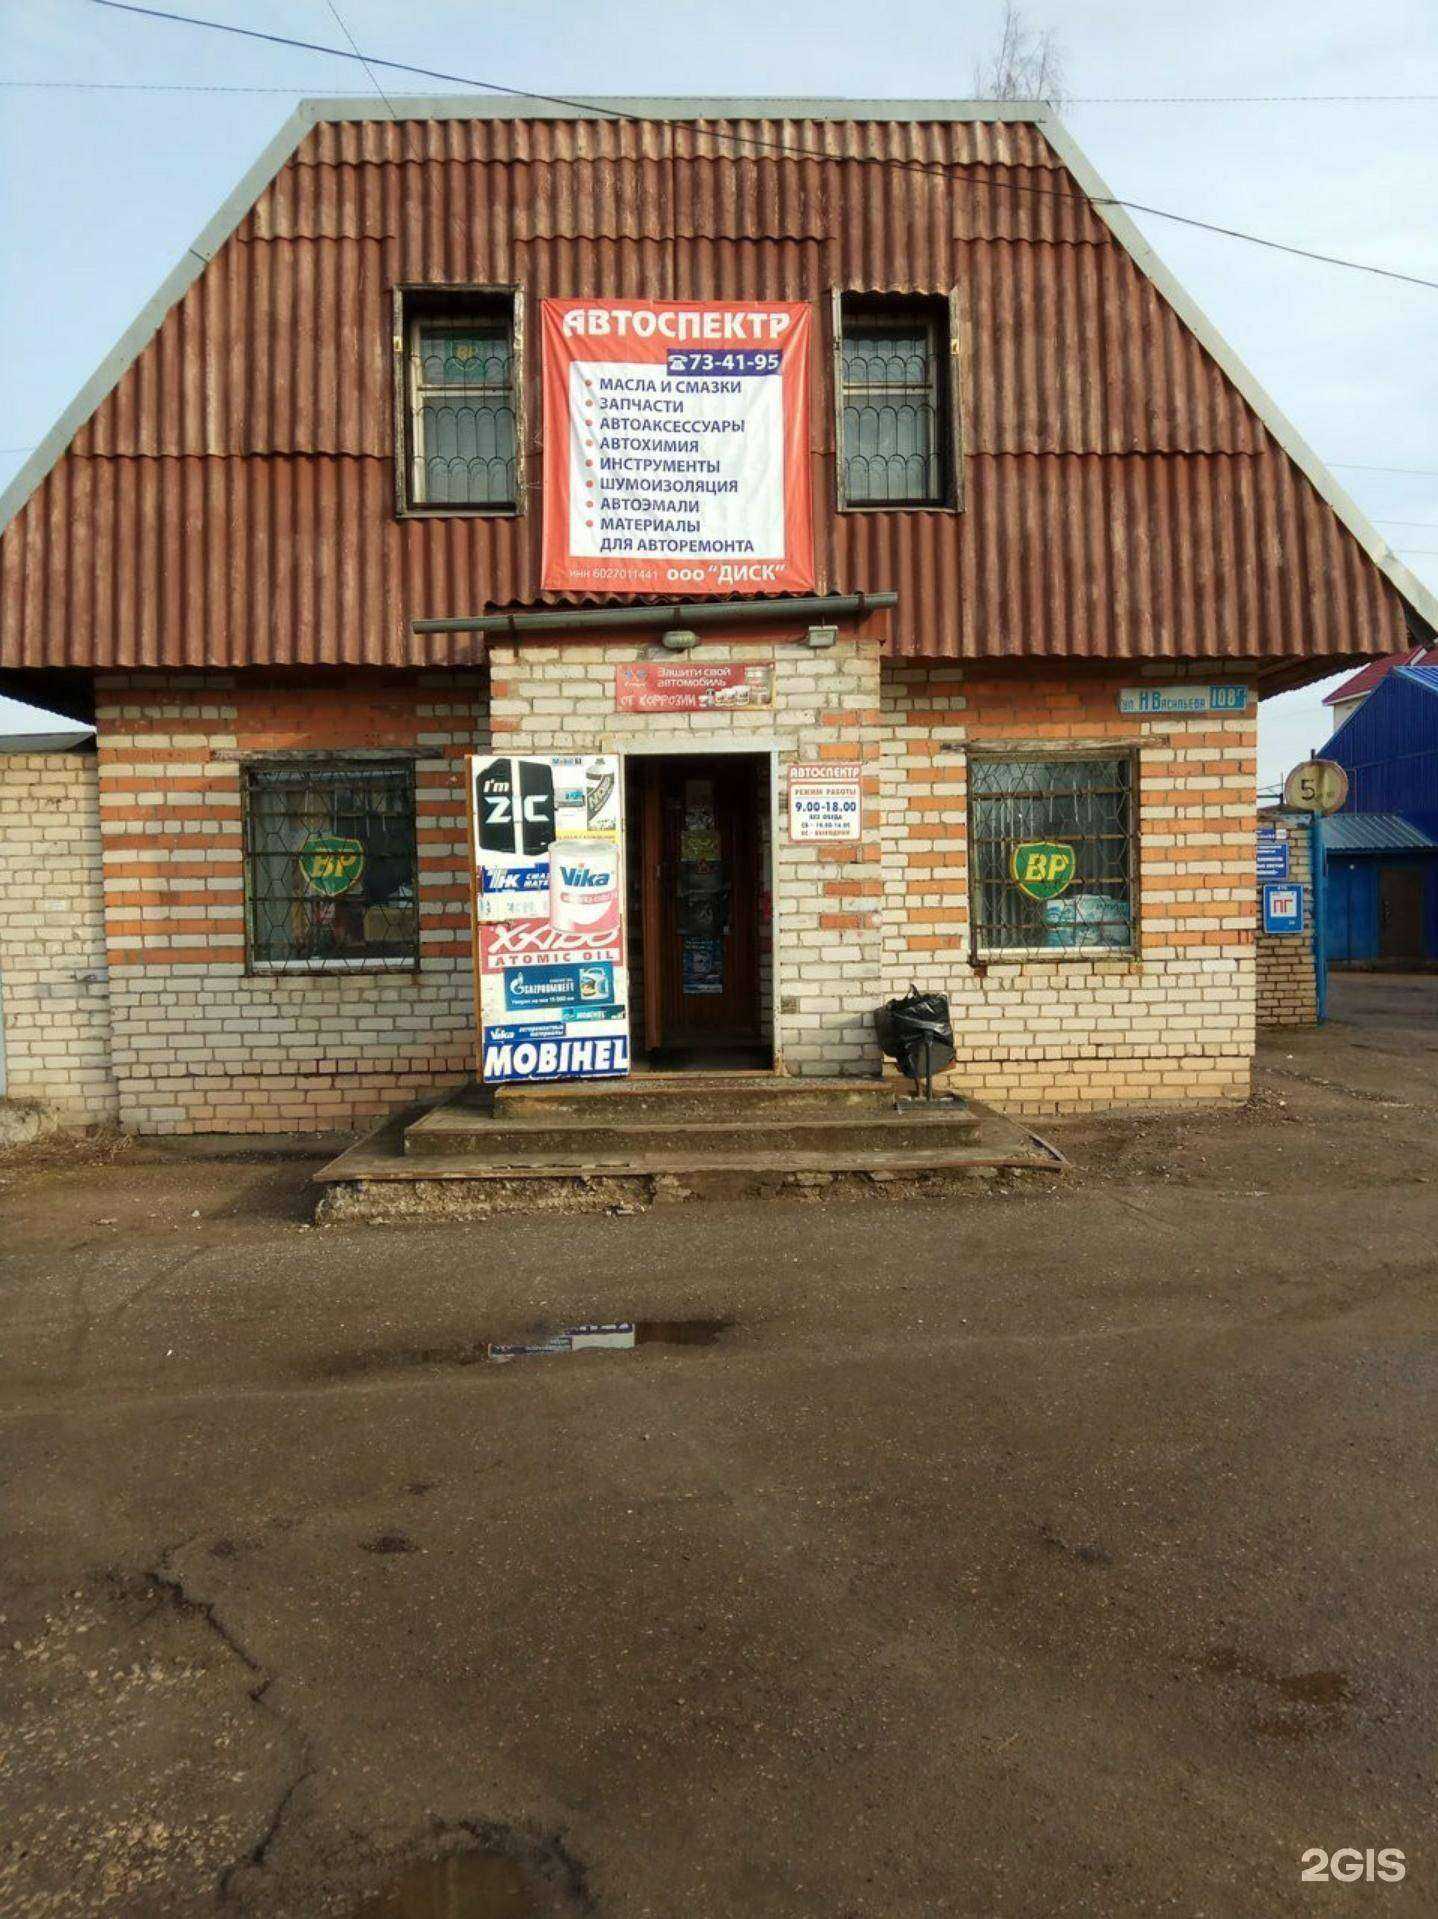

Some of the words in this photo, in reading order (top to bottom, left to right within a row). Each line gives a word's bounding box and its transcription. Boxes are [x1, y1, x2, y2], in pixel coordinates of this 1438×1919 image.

[563, 308, 792, 341] АВТОСПЕКТР
[690, 354, 780, 370] 73-41-95
[599, 378, 657, 392] МАСЛА
[661, 380, 672, 392] И
[676, 379, 742, 394] СМАЗКИ
[599, 399, 684, 413] ЗАПЧАСТИ
[599, 418, 746, 432] АВТОАКСЕССУАРЫ
[599, 437, 699, 452] АВТОХИМИЯ
[599, 457, 721, 473] ИНСТРУМЕНТЫ
[599, 478, 739, 494] ШУМОИЗОЛЯЦИЯ
[600, 498, 700, 512] АВТОЭМАЛИ
[600, 518, 701, 532] МАТЕРИАЛЫ
[599, 539, 633, 552] ДЛЯ
[637, 539, 755, 552] АВТОРЕМОНТА
[790, 767, 859, 778] АВТОСПЕКТР
[1301, 778, 1315, 800] 5
[795, 801, 856, 812] 9.00-18.00
[1024, 852, 1070, 881] BP
[560, 863, 611, 888] Vika
[495, 952, 571, 967] ATOMIC
[583, 950, 615, 961] OIL
[484, 1040, 628, 1076] MOBIHEL
